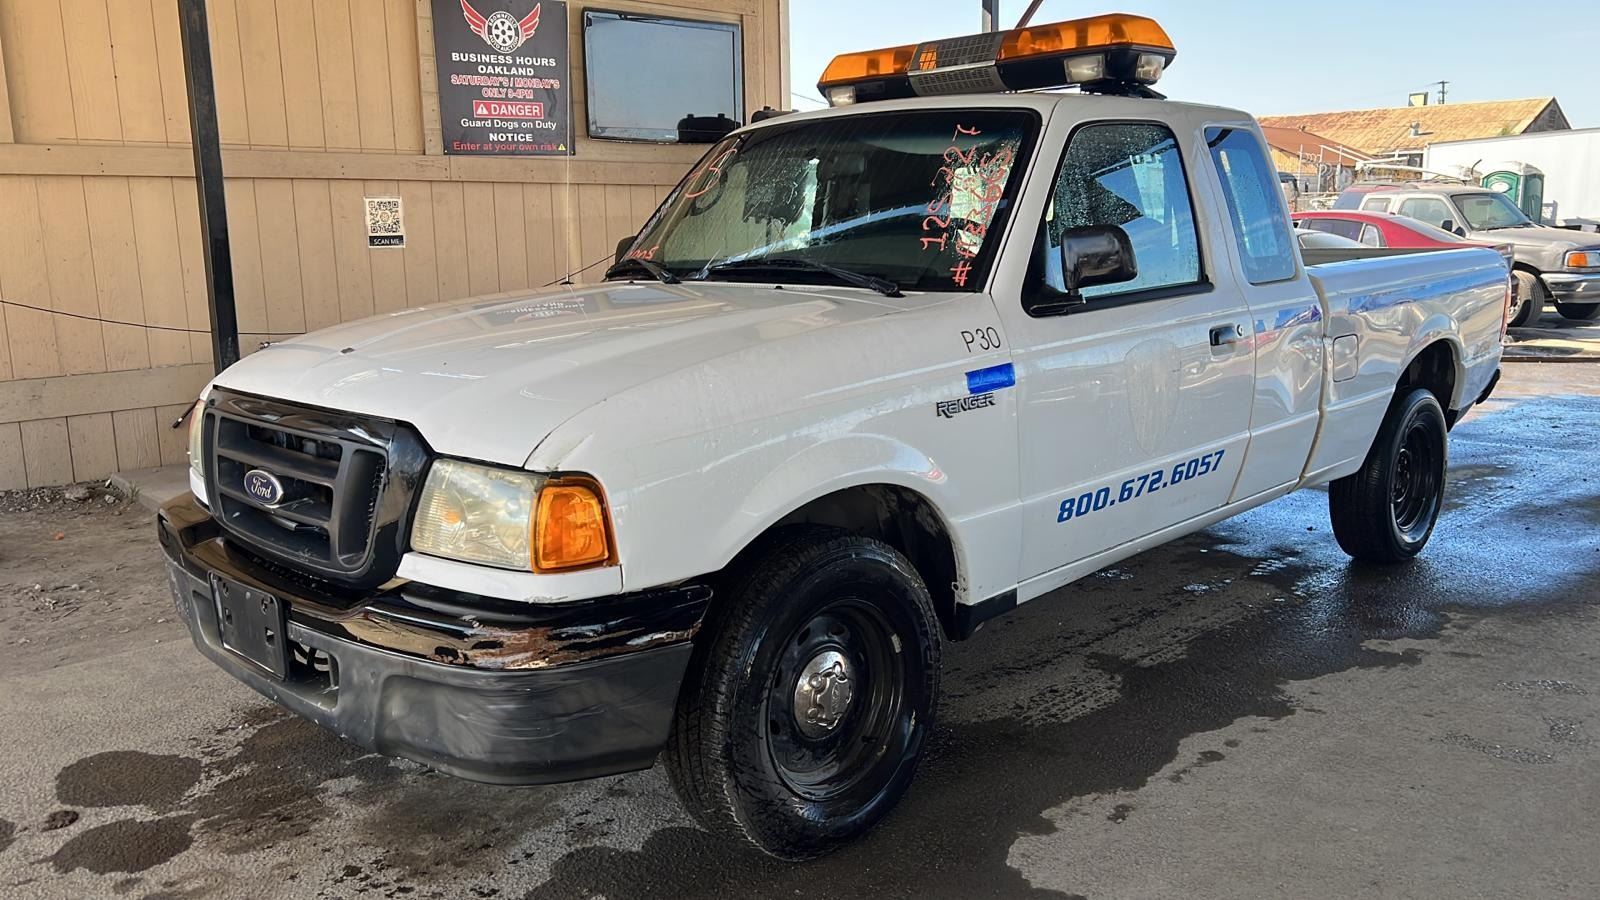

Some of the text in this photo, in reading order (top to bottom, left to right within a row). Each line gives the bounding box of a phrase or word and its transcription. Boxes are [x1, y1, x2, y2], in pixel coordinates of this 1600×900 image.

[451, 52, 556, 67] BUSINESS HOURS
[477, 65, 534, 76] OAKLAND
[482, 87, 534, 99] ONLY 9-4PM
[490, 103, 541, 116] DANGER
[460, 118, 557, 130] Guard Dogs on Duty
[489, 133, 533, 142] NOTICE
[453, 141, 480, 151] Enter
[482, 142, 492, 151] at
[494, 143, 516, 152] your
[540, 142, 558, 151] risk
[960, 326, 1001, 353] P30
[936, 392, 996, 419] RANGER
[251, 475, 272, 499] Ford
[1057, 449, 1225, 523] 800.672.6057
